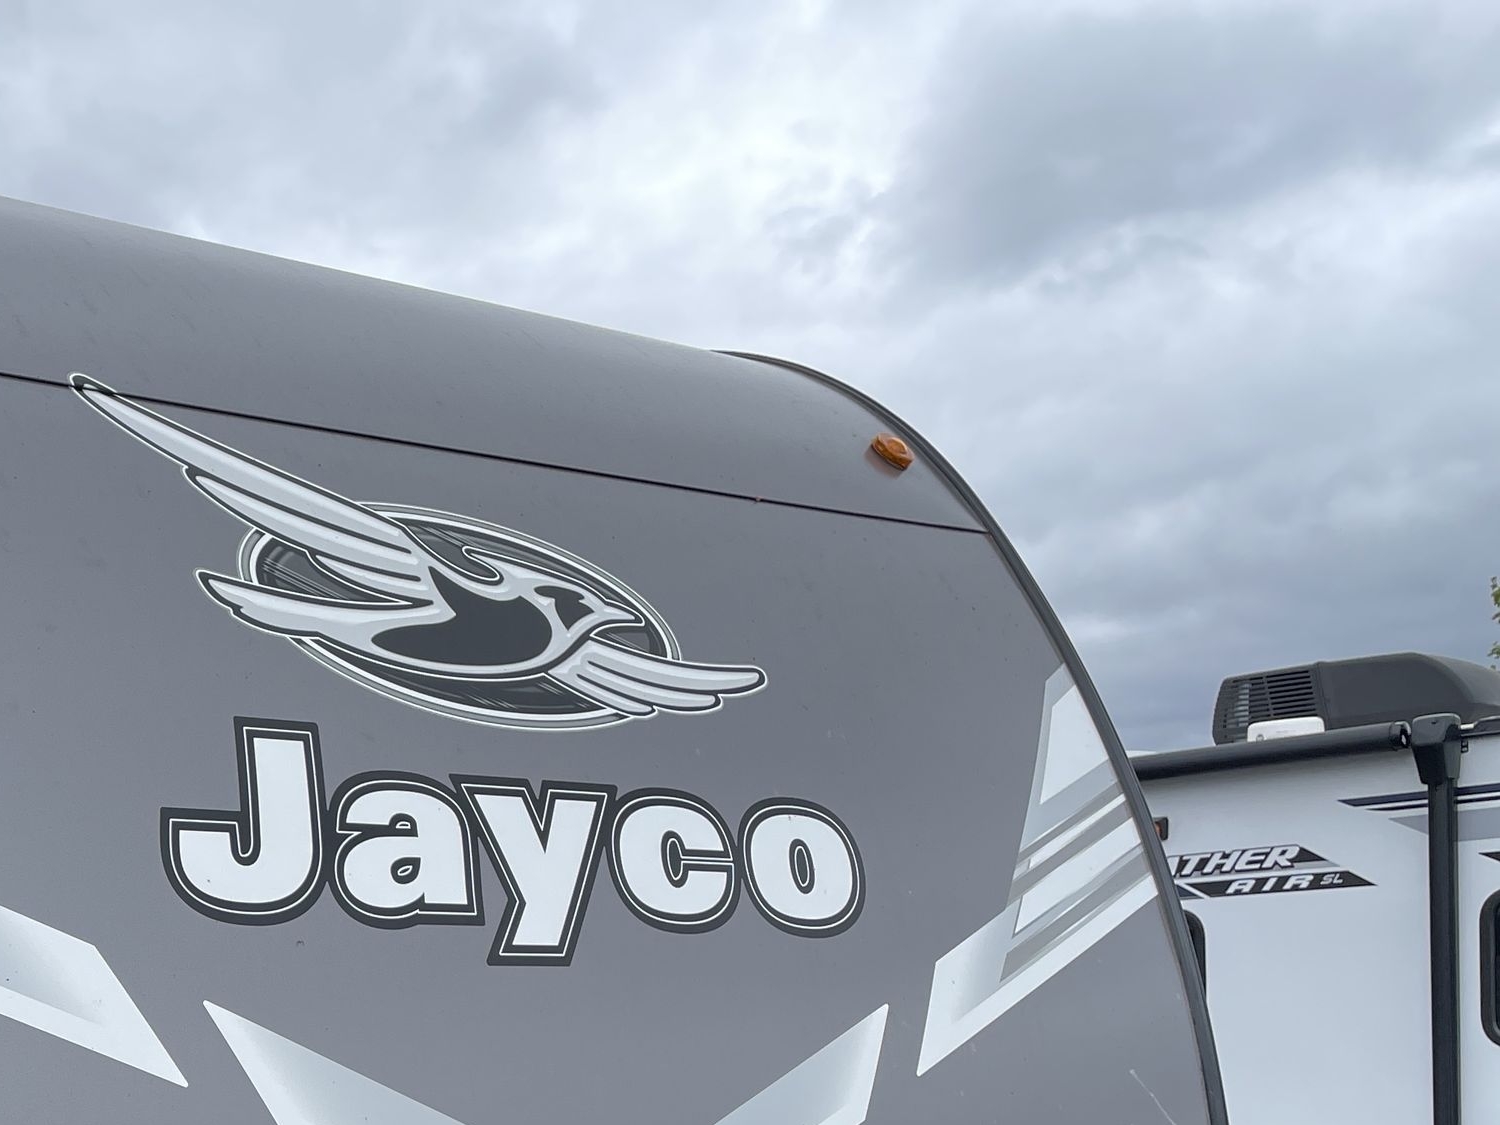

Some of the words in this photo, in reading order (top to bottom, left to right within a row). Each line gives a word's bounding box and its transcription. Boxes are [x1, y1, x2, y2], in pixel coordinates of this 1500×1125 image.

[161, 717, 865, 966] Jayco
[1226, 874, 1315, 894] AIR
[1320, 874, 1343, 885] SL
